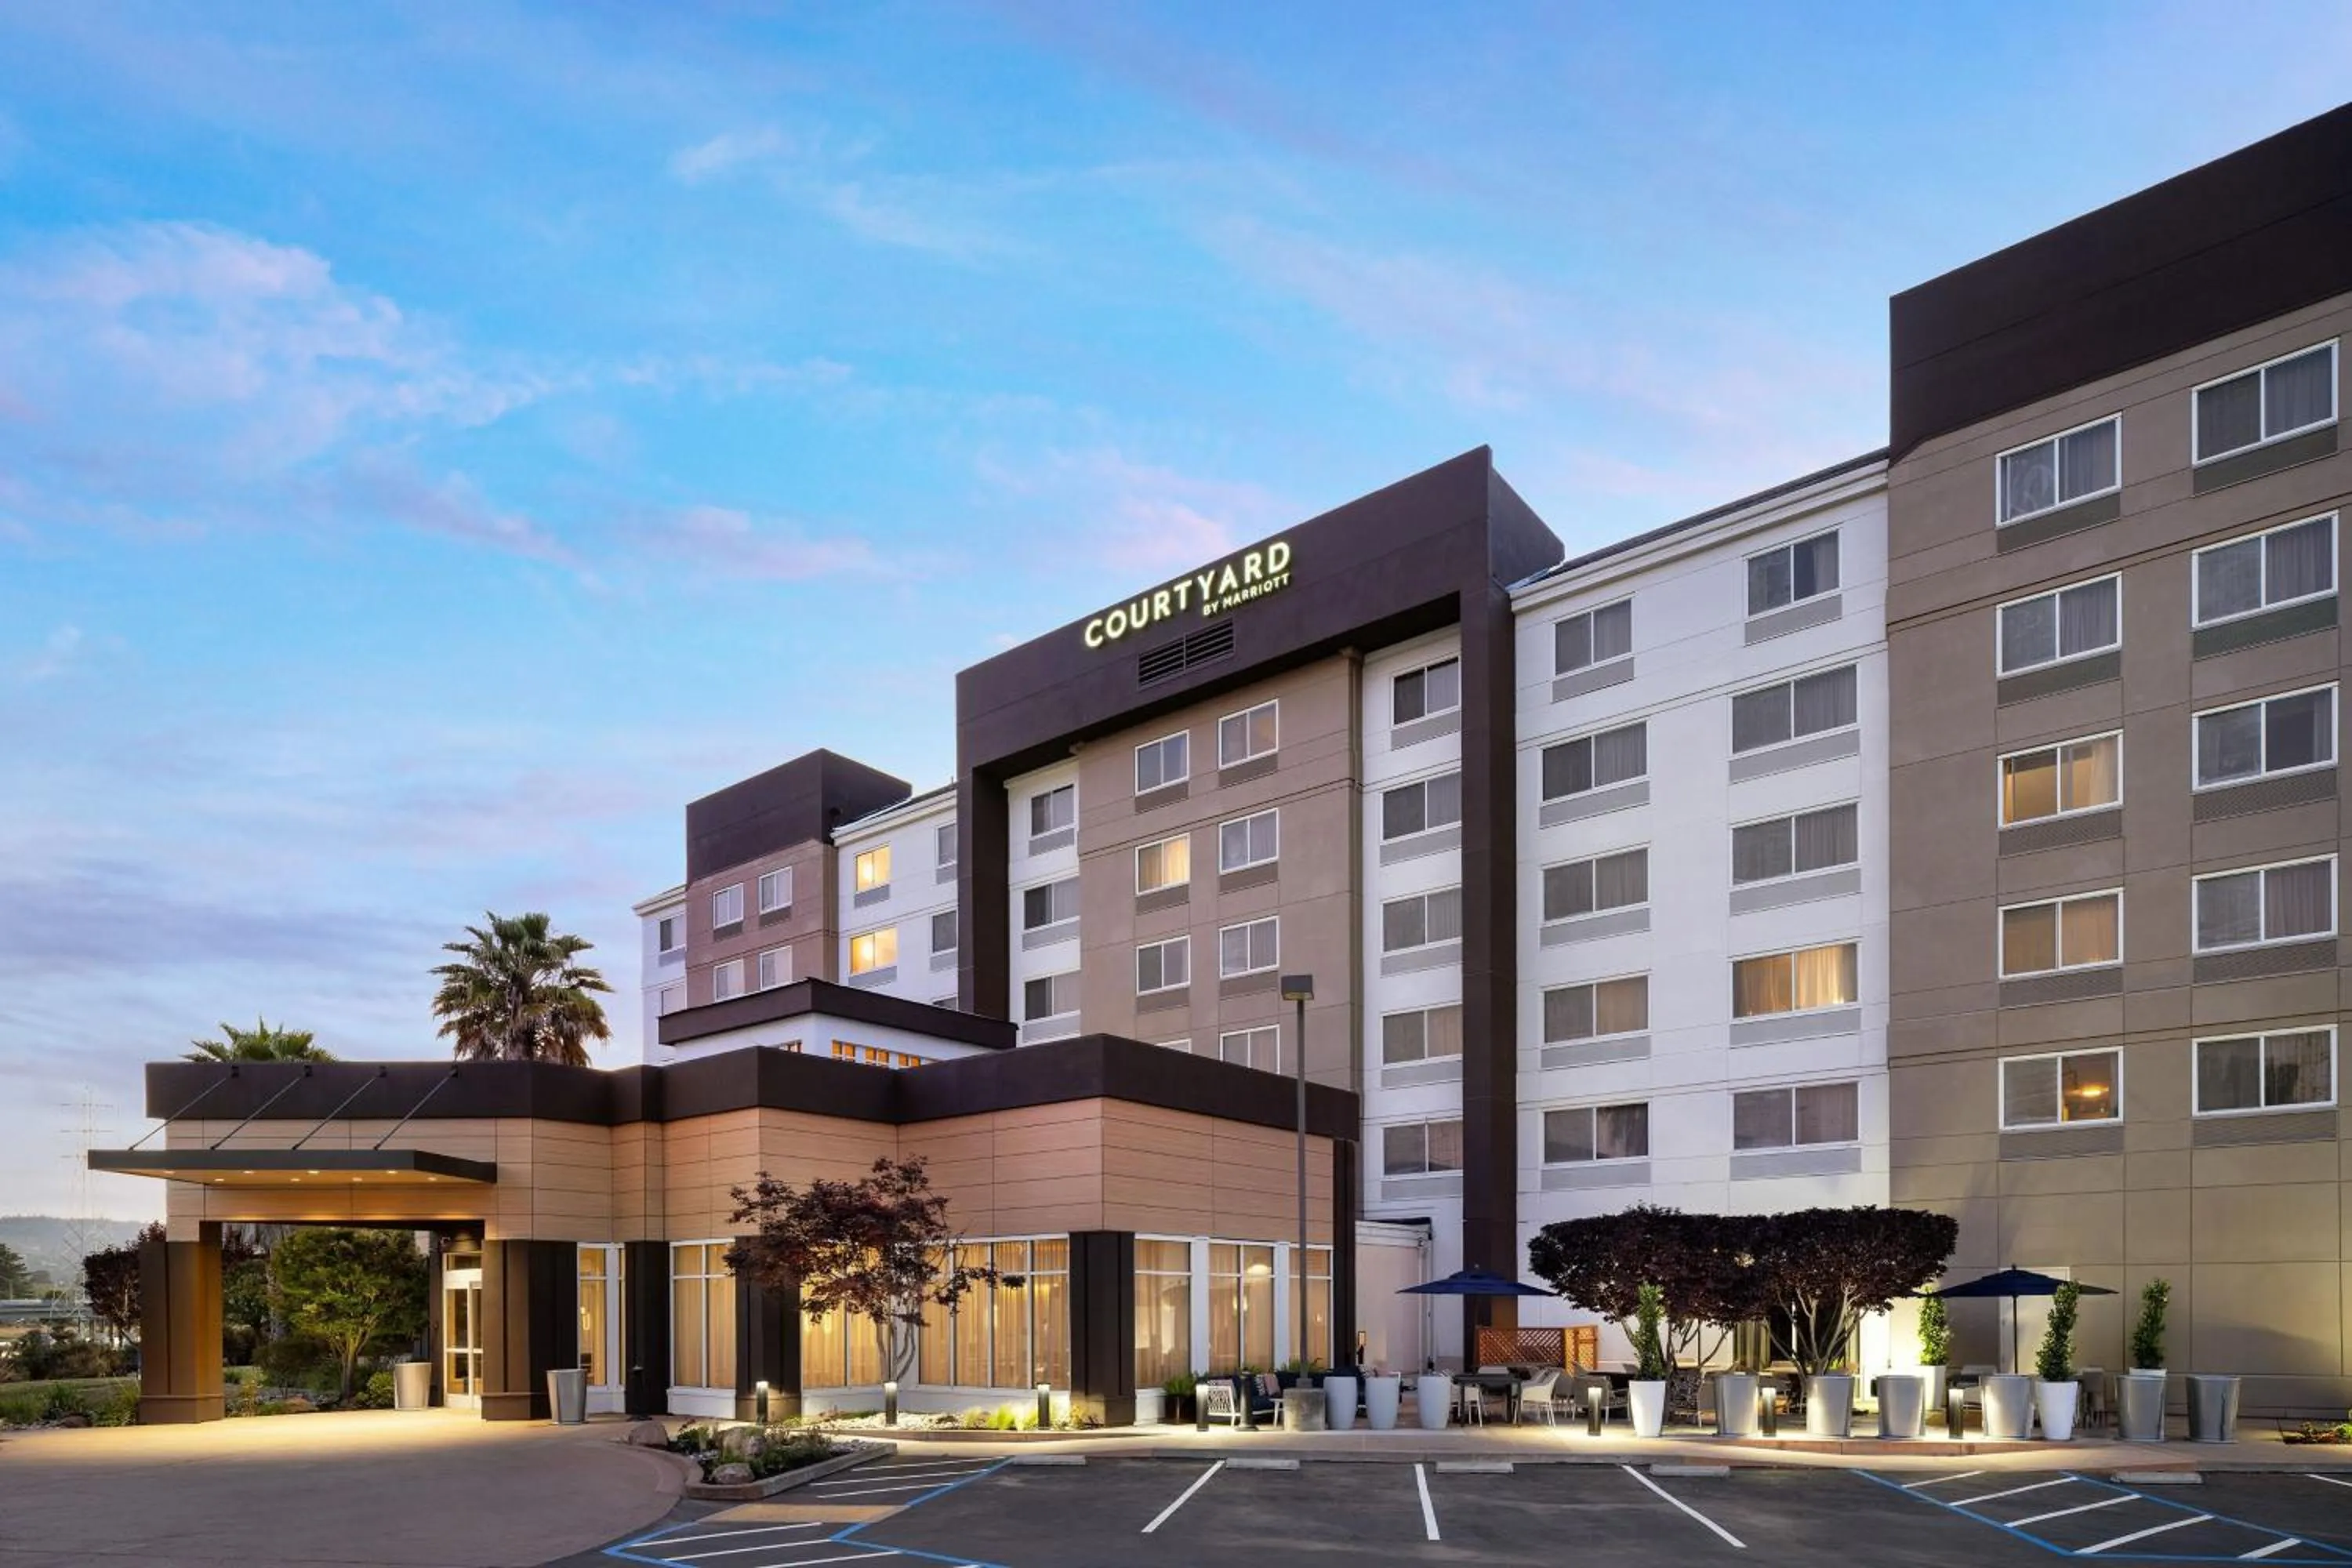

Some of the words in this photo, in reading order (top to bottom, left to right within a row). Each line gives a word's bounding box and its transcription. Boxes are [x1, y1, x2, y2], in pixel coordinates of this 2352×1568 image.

[1083, 541, 1290, 648] COURTYARD
[1203, 601, 1219, 616] BY
[1222, 572, 1290, 609] MARRIOTT
